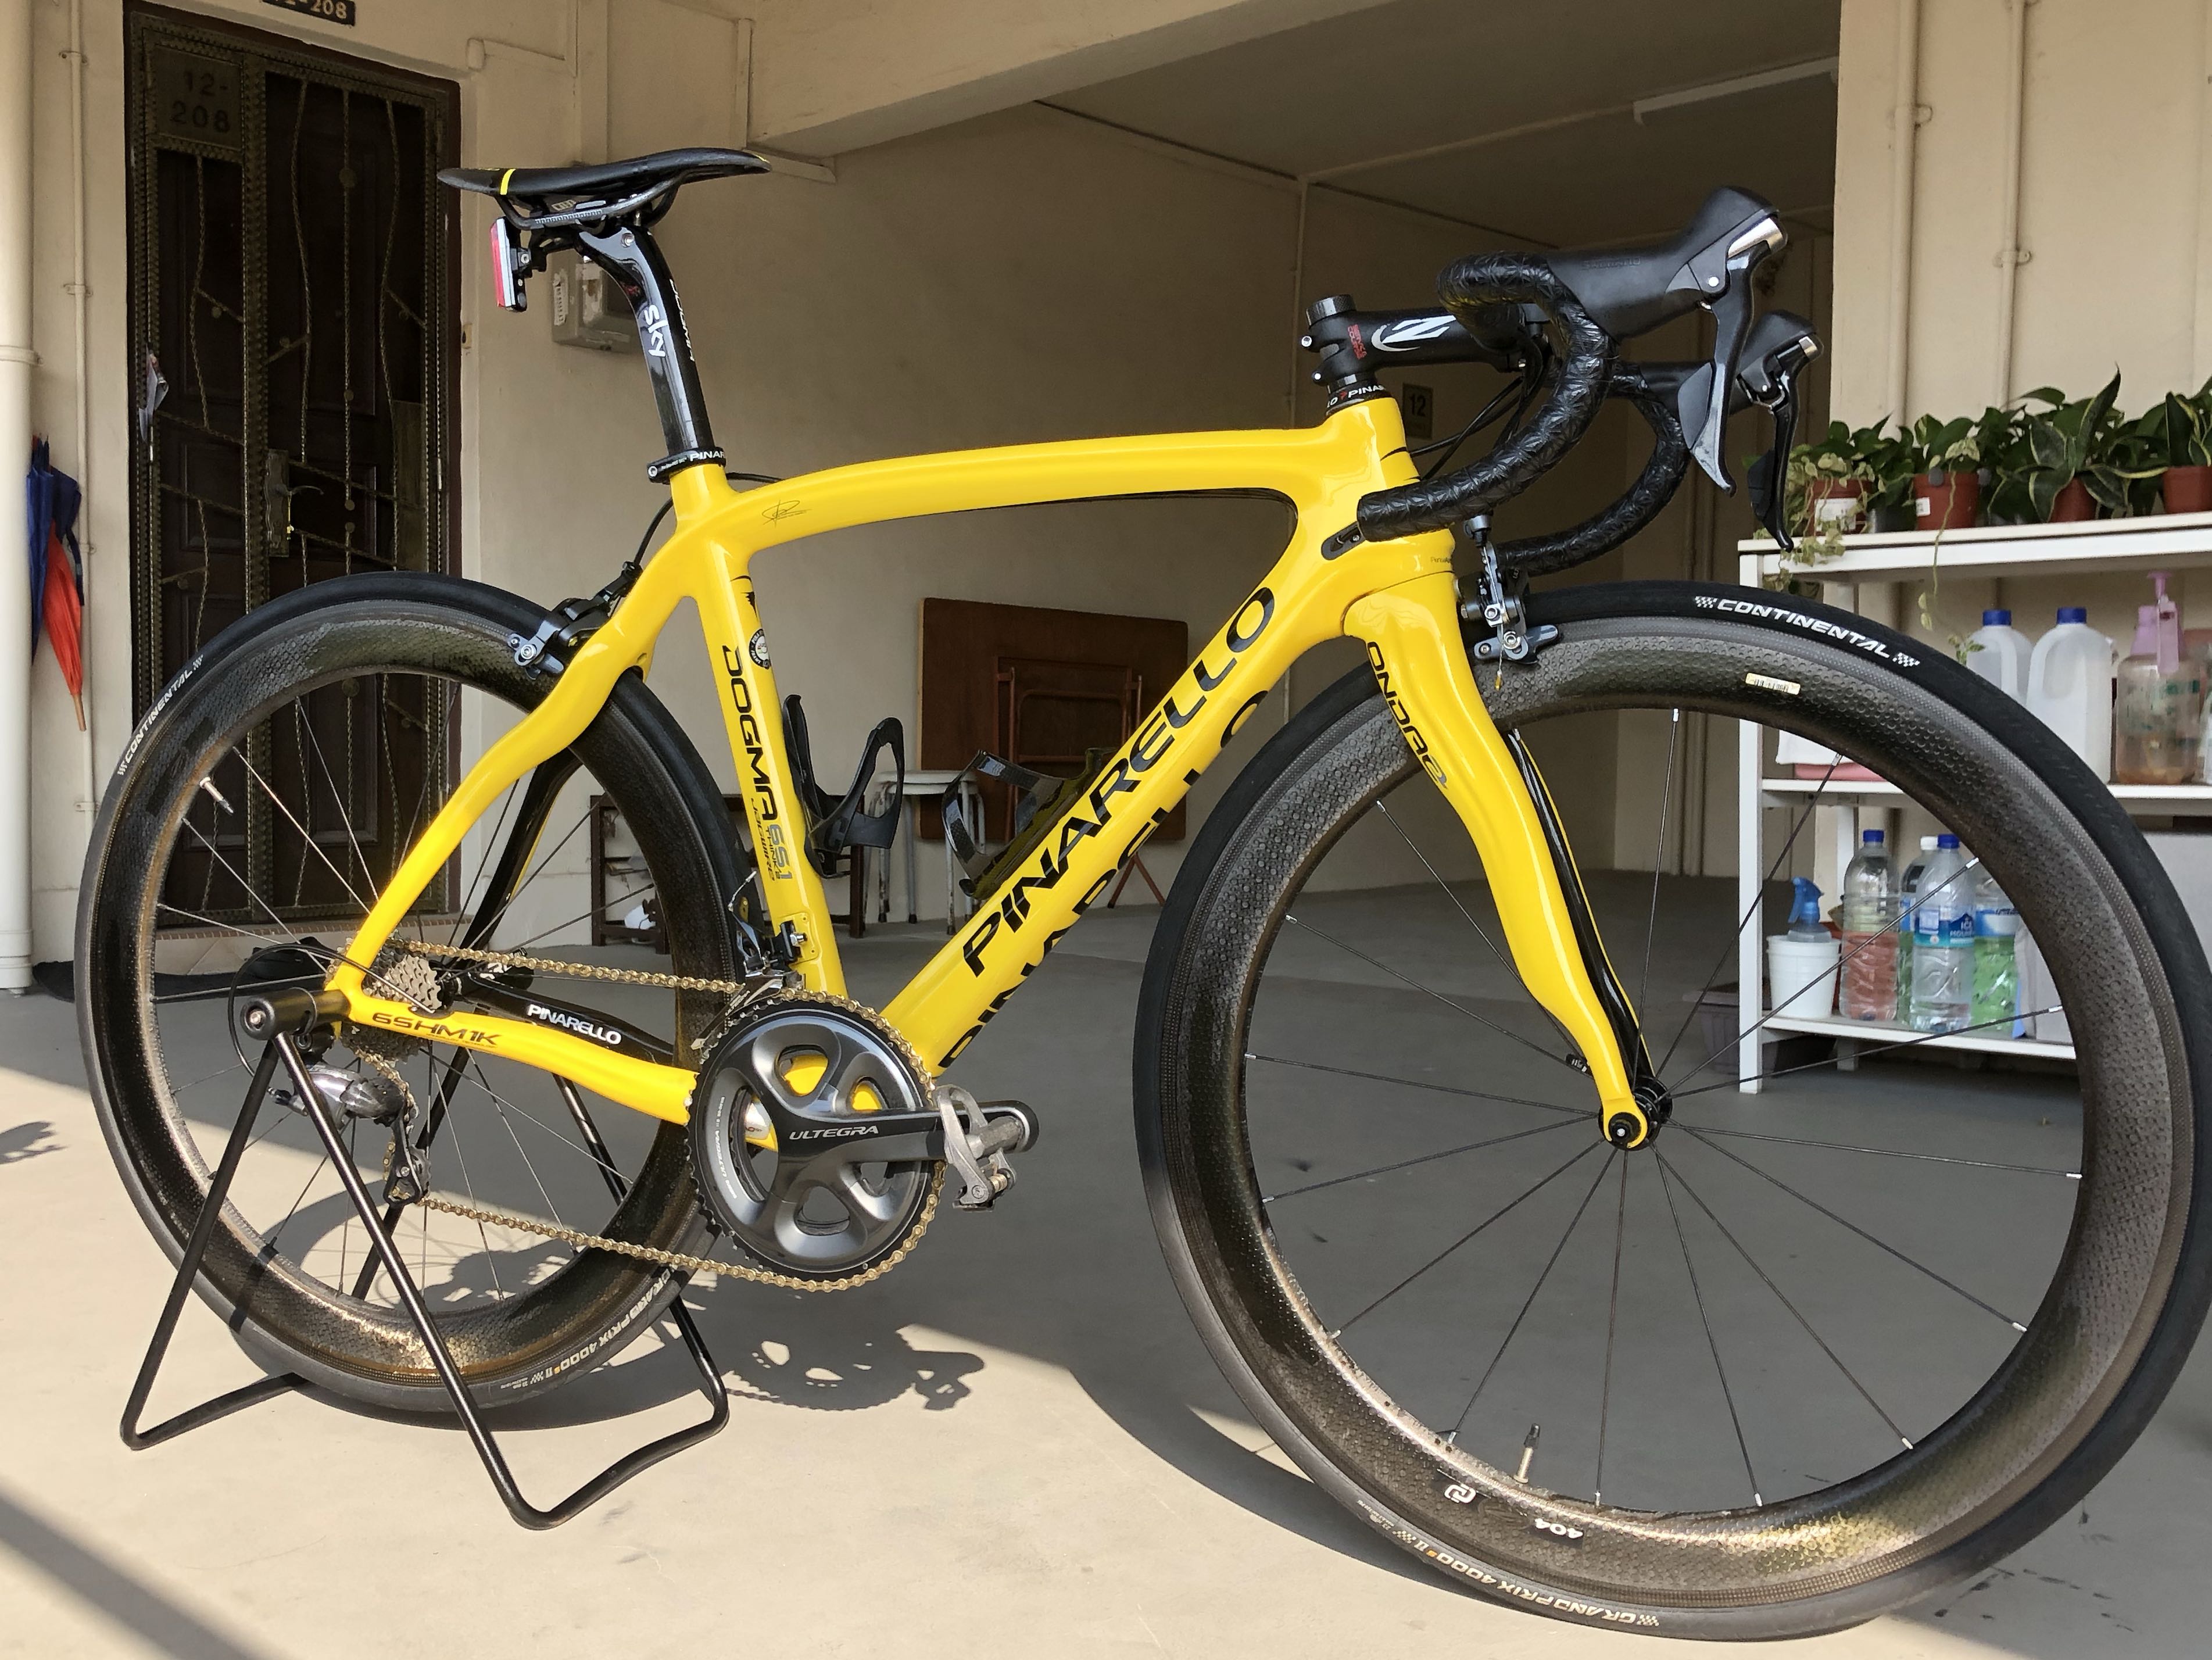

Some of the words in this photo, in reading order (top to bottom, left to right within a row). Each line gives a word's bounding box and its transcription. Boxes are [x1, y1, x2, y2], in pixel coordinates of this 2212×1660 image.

[171, 101, 231, 133] 208
[1409, 393, 1426, 417] 12
[1716, 598, 1891, 659] CONTINENTAL
[125, 669, 192, 764] CONTINENTAL
[722, 644, 778, 821] DOGMA
[962, 586, 1275, 978] PINARELLO
[527, 1004, 622, 1045] PINARELLO
[789, 1124, 879, 1140] ULTEGRA
[599, 1316, 632, 1347] PRIX
[1535, 1518, 1583, 1540] 404
[1497, 1580, 1554, 1608] PRIX
[1554, 1599, 1636, 1625] GRAND
